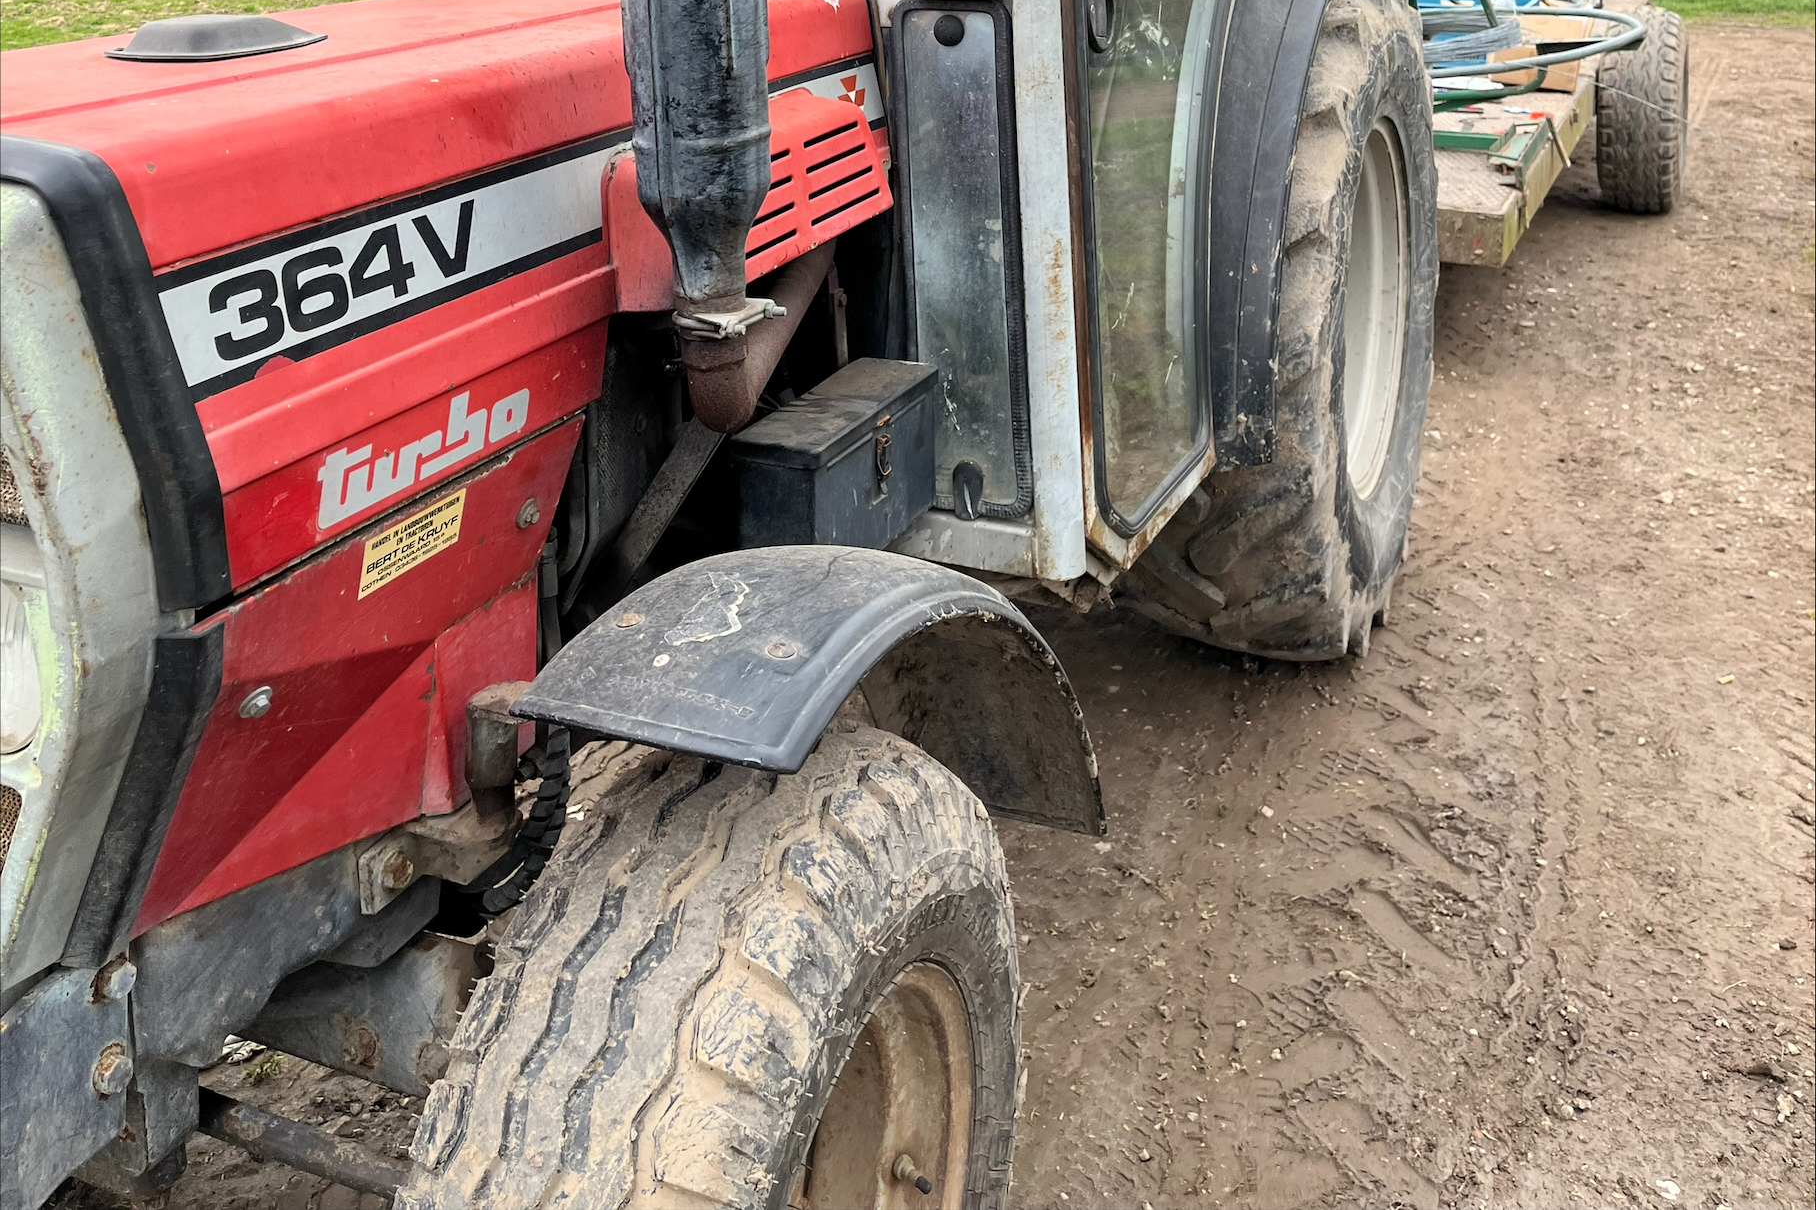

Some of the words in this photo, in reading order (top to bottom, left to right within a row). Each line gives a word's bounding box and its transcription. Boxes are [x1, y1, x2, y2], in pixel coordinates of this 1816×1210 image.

[316, 387, 530, 531] turbo
[366, 547, 401, 575] BERT
[401, 539, 416, 554] DE
[417, 514, 459, 545] KRUYF
[371, 533, 392, 551] HANDEL
[393, 528, 401, 539] IN
[396, 535, 404, 546] EN
[405, 519, 434, 541] TRACTOREN
[377, 540, 431, 576] OSSENWAARD
[361, 570, 392, 592] COTHEN
